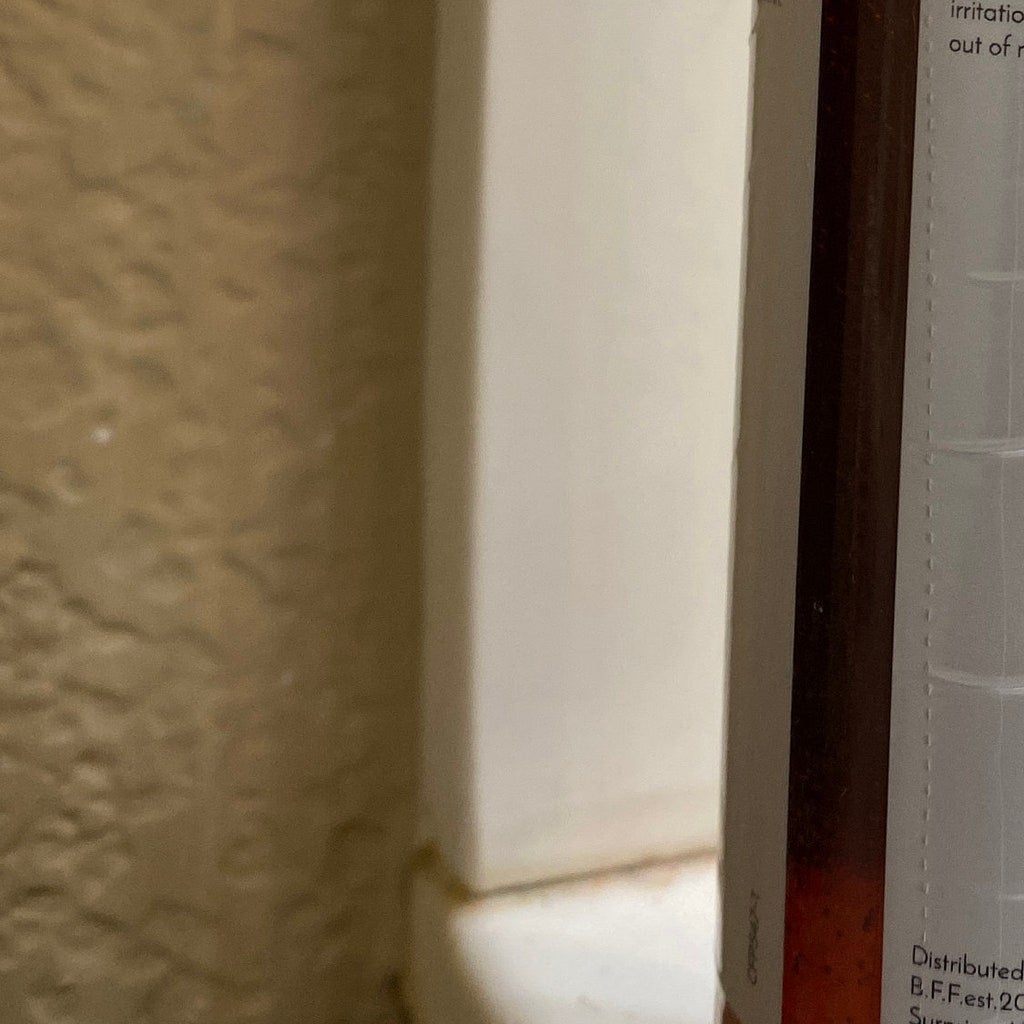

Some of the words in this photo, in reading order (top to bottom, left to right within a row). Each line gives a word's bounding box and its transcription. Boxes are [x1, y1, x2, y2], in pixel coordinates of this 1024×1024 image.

[949, 36, 983, 55] out
[989, 34, 1012, 58] of
[912, 944, 1024, 982] Distributed
